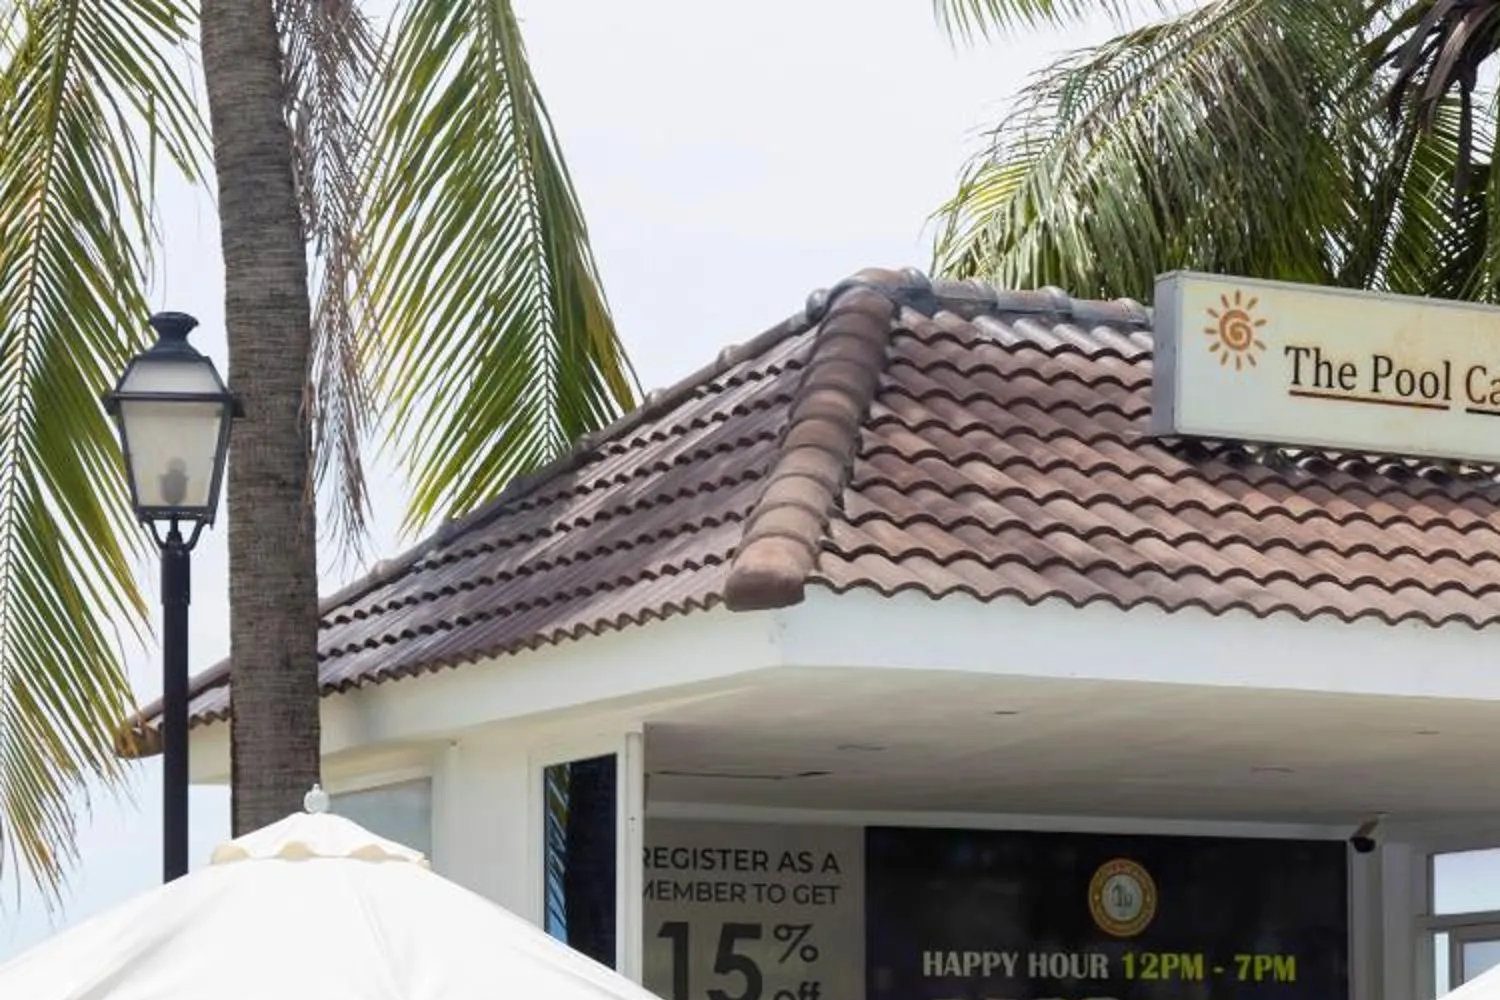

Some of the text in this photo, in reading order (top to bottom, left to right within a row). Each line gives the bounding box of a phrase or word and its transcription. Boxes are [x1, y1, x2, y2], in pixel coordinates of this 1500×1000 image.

[1284, 346, 1358, 391] The
[1371, 354, 1452, 401] Pool
[777, 850, 813, 873] AS
[820, 852, 841, 874] A
[750, 882, 787, 905] TO
[792, 884, 841, 906] GET
[923, 951, 1019, 978] HAPPY
[1028, 952, 1109, 979] HOUR
[1122, 953, 1204, 980] 12PM
[1234, 955, 1296, 981] 7PM
